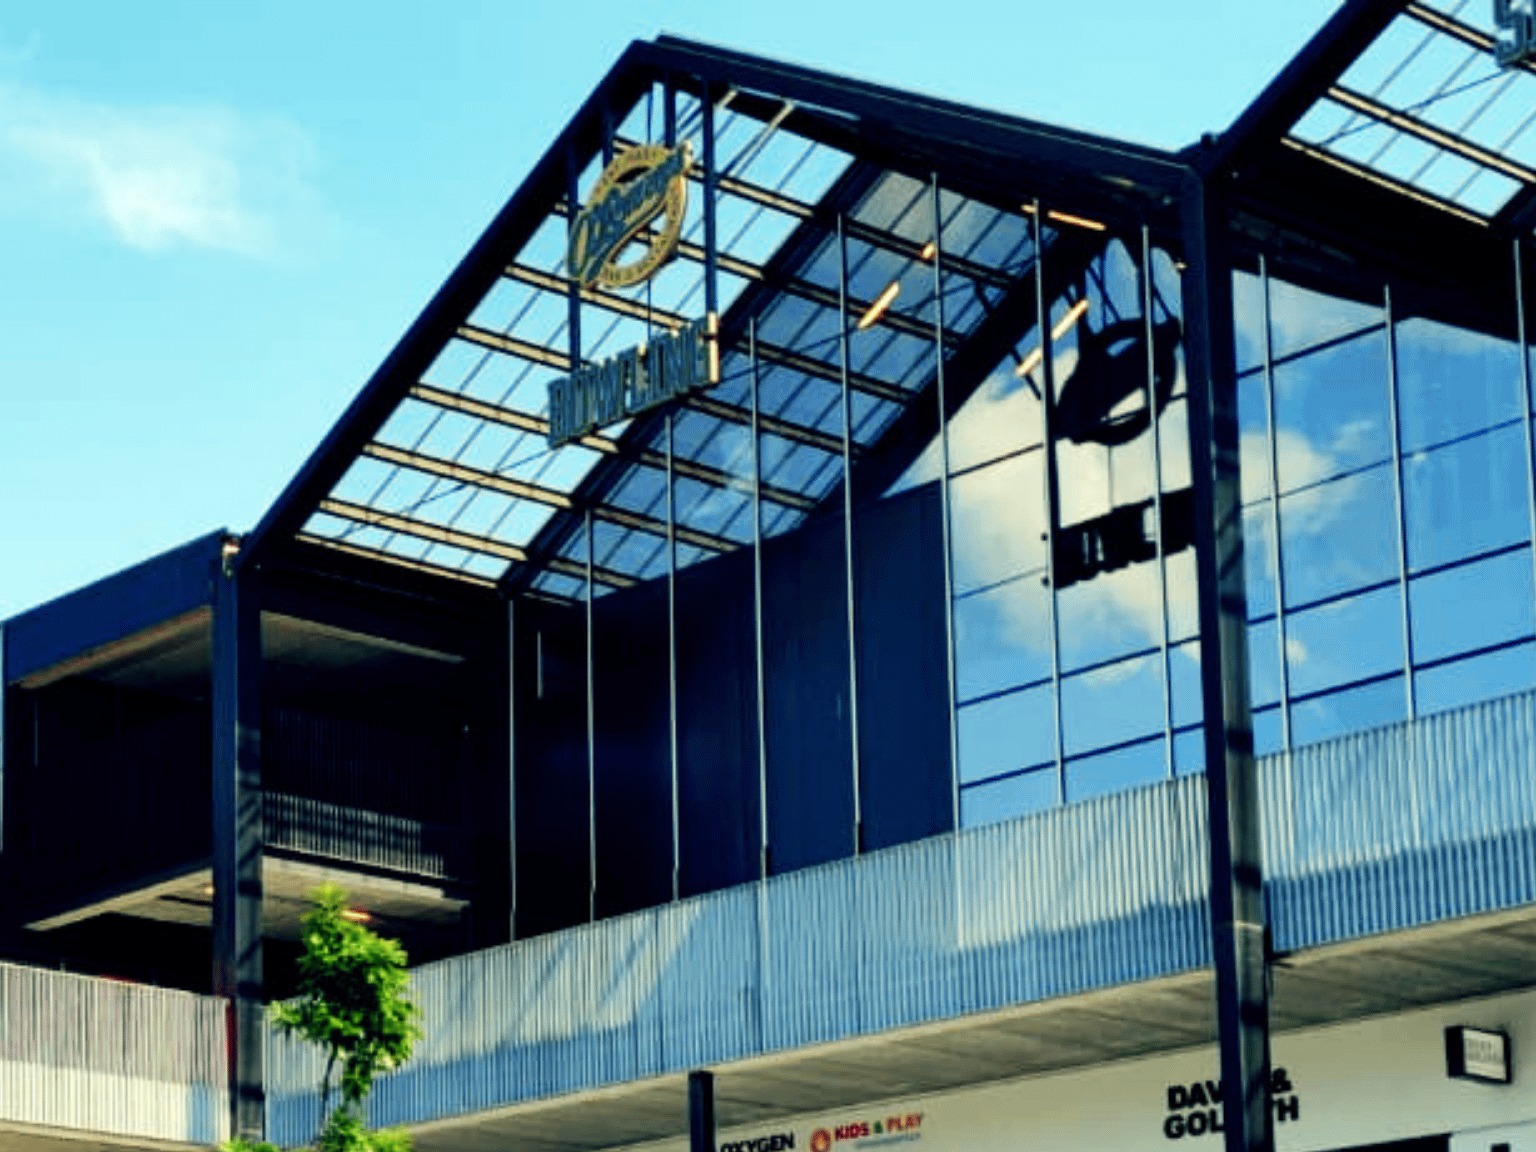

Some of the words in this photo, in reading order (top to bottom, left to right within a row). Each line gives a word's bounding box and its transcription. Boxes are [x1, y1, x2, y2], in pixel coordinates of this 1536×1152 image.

[1167, 1080, 1232, 1111] DAV
[834, 1121, 869, 1141] KIDS
[886, 1112, 923, 1132] PLAY
[1164, 1095, 1299, 1139] GOLH
